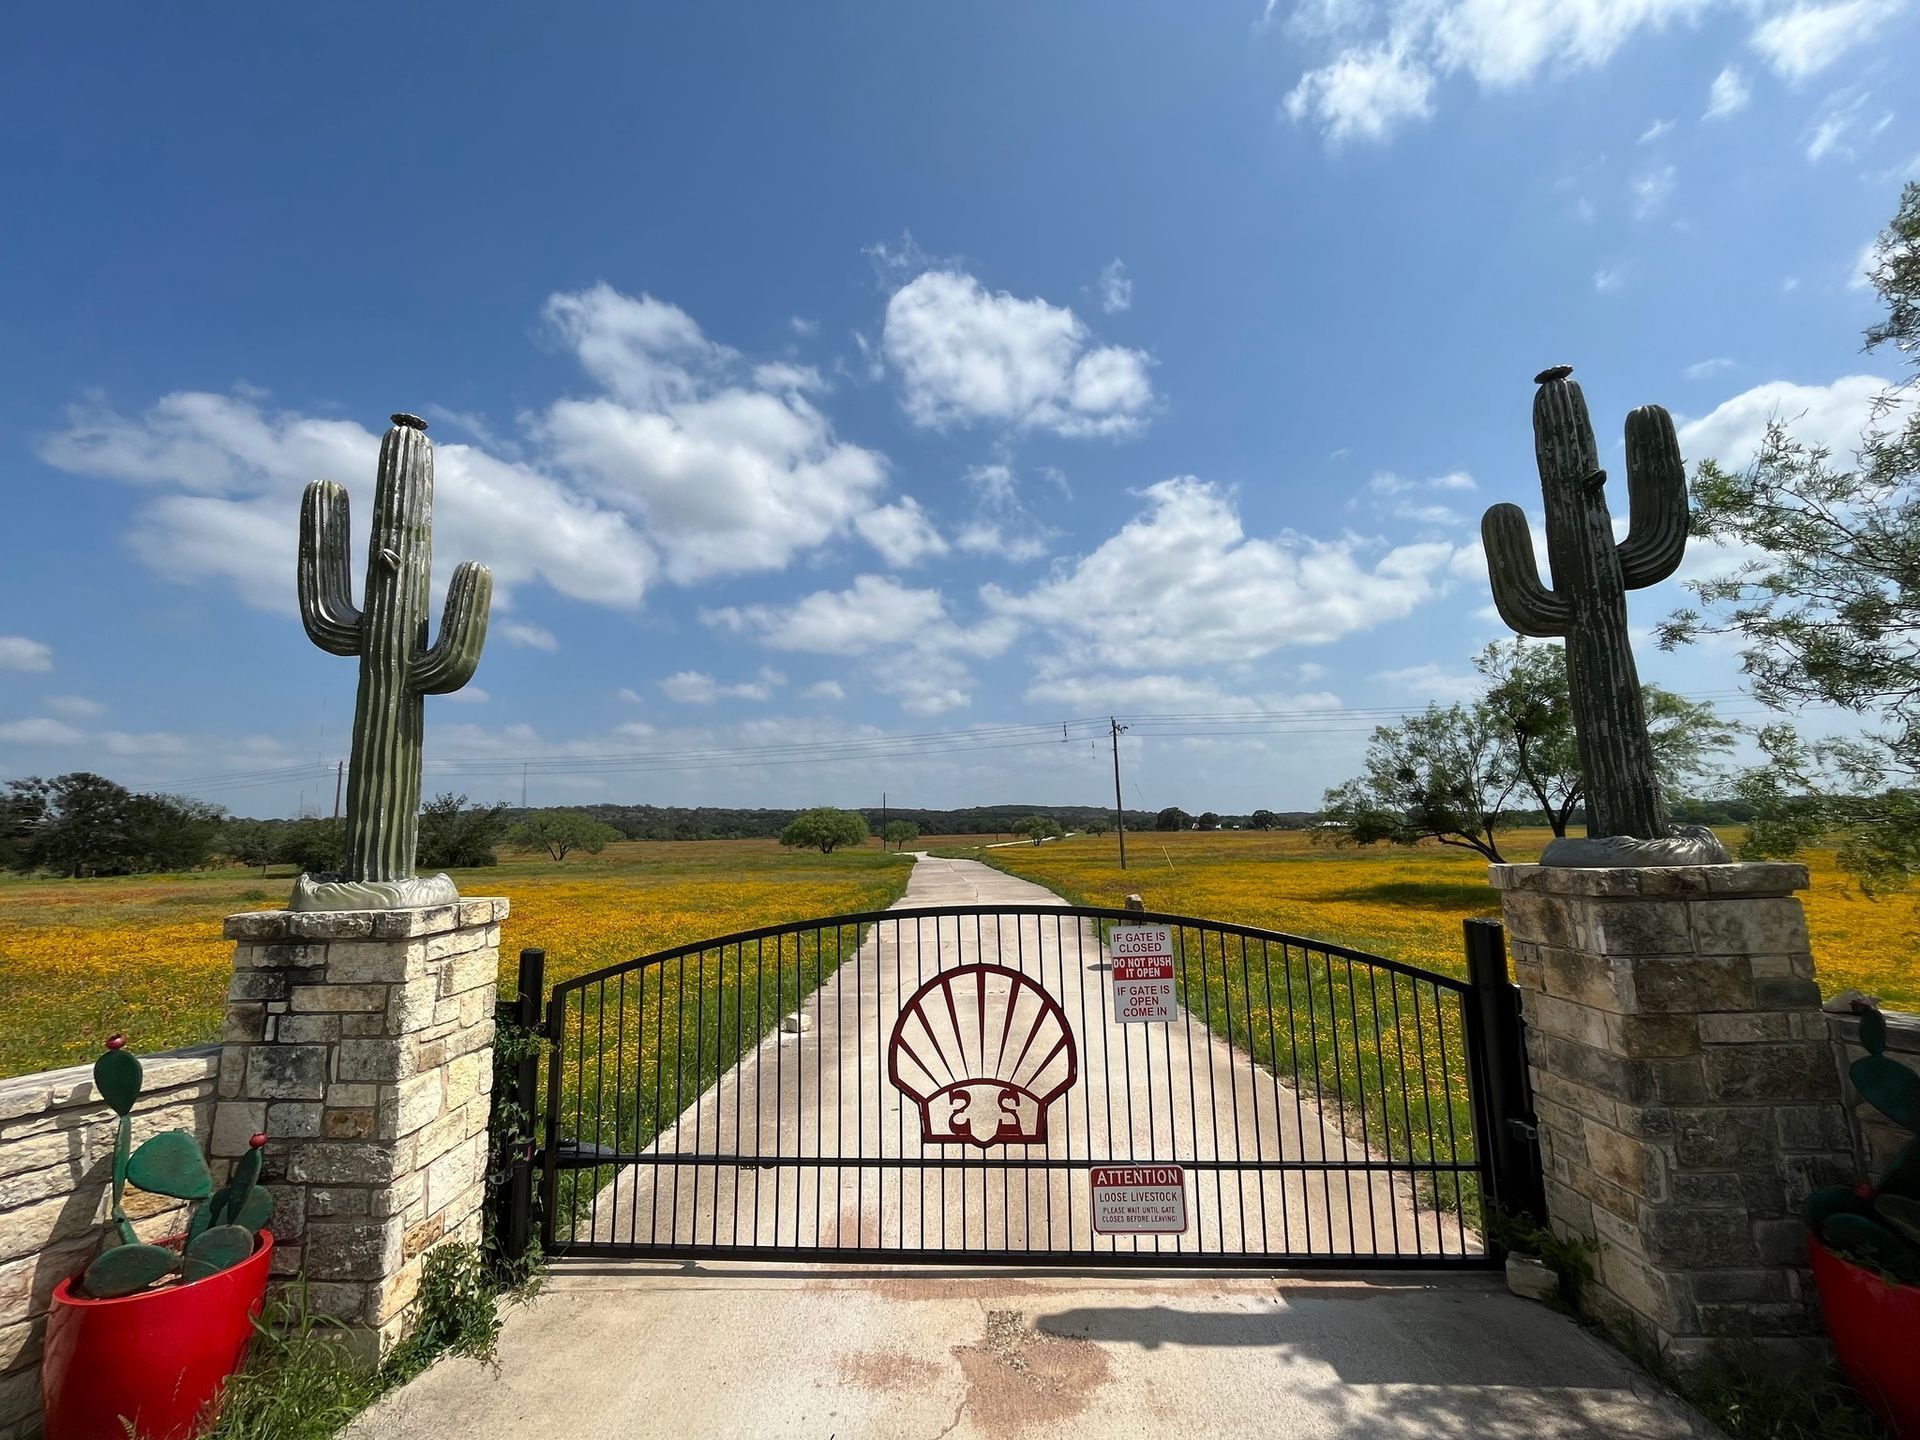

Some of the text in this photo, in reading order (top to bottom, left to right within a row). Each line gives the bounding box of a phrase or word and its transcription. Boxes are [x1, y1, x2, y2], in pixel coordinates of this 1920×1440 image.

[1113, 931, 1166, 943] IF GATE IS
[1119, 943, 1161, 952] CLOSED
[1113, 957, 1171, 968] DO NOT PUSH
[1125, 967, 1160, 978] IT OPEN
[1117, 984, 1170, 996] IF GATE IS
[1130, 996, 1159, 1006] OPEN
[1123, 1006, 1167, 1017] COME IN
[1097, 1169, 1178, 1184] ATTENTION
[1099, 1191, 1178, 1203] LOOSE LIVESTOCK
[1103, 1206, 1125, 1214] PLEASE
[1142, 1206, 1159, 1214] UNTIL
[1101, 1215, 1125, 1223] CLOSES
[1126, 1215, 1149, 1223] BEFORE
